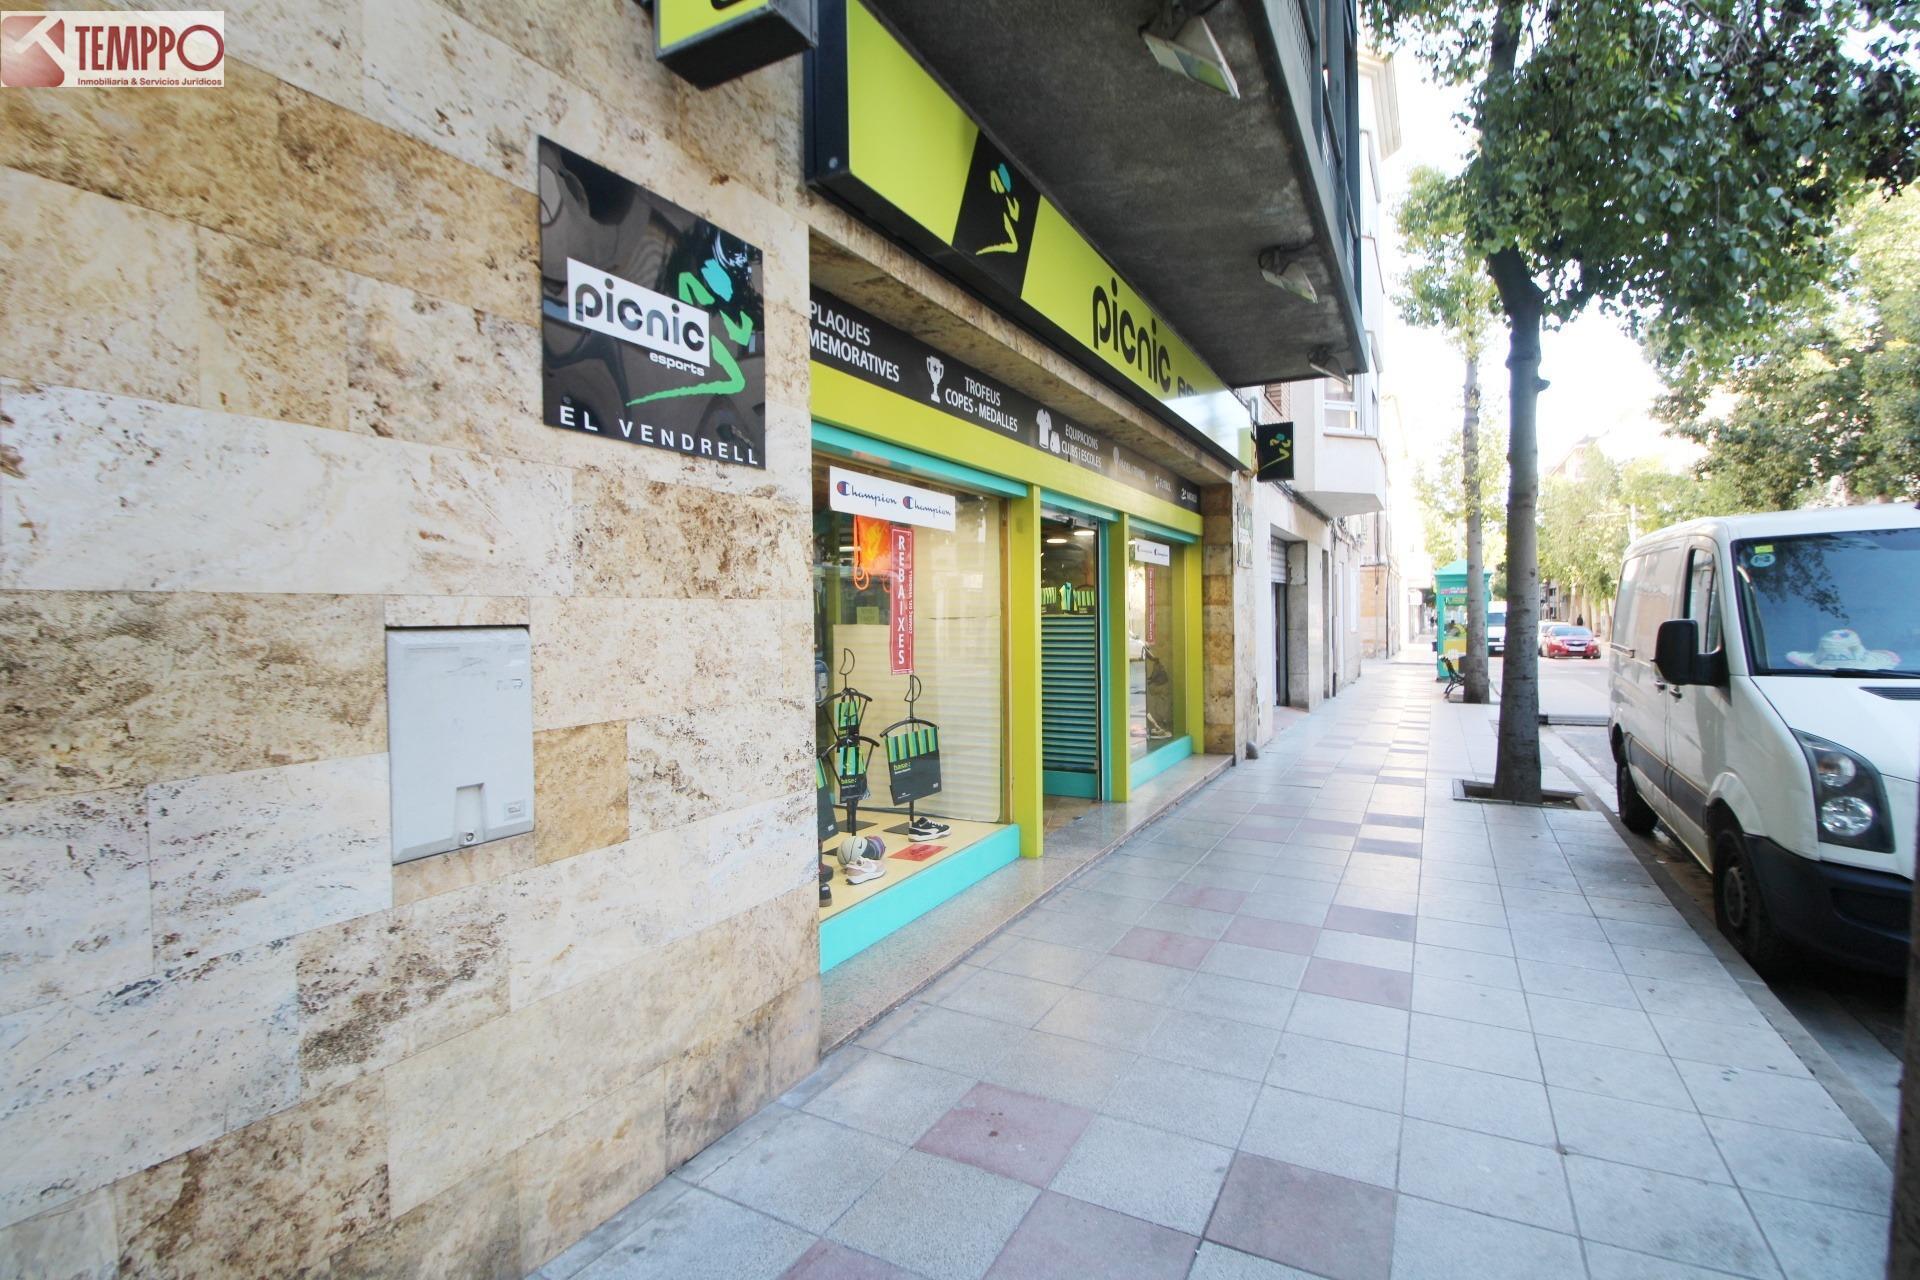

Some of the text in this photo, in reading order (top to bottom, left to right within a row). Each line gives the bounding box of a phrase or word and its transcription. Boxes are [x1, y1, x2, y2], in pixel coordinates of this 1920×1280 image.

[575, 278, 705, 352] picnic
[809, 301, 871, 346] PLAQUES
[1092, 277, 1171, 393] picnic
[649, 352, 705, 377] esports
[945, 388, 1018, 432] COPES MEDALLES
[964, 376, 1001, 407] TROFEUS
[560, 405, 758, 465] EL VENDRELL
[1065, 424, 1099, 450] EQUIPACIONS
[836, 480, 951, 517] Champion Champion
[897, 535, 905, 665] REBAIXES
